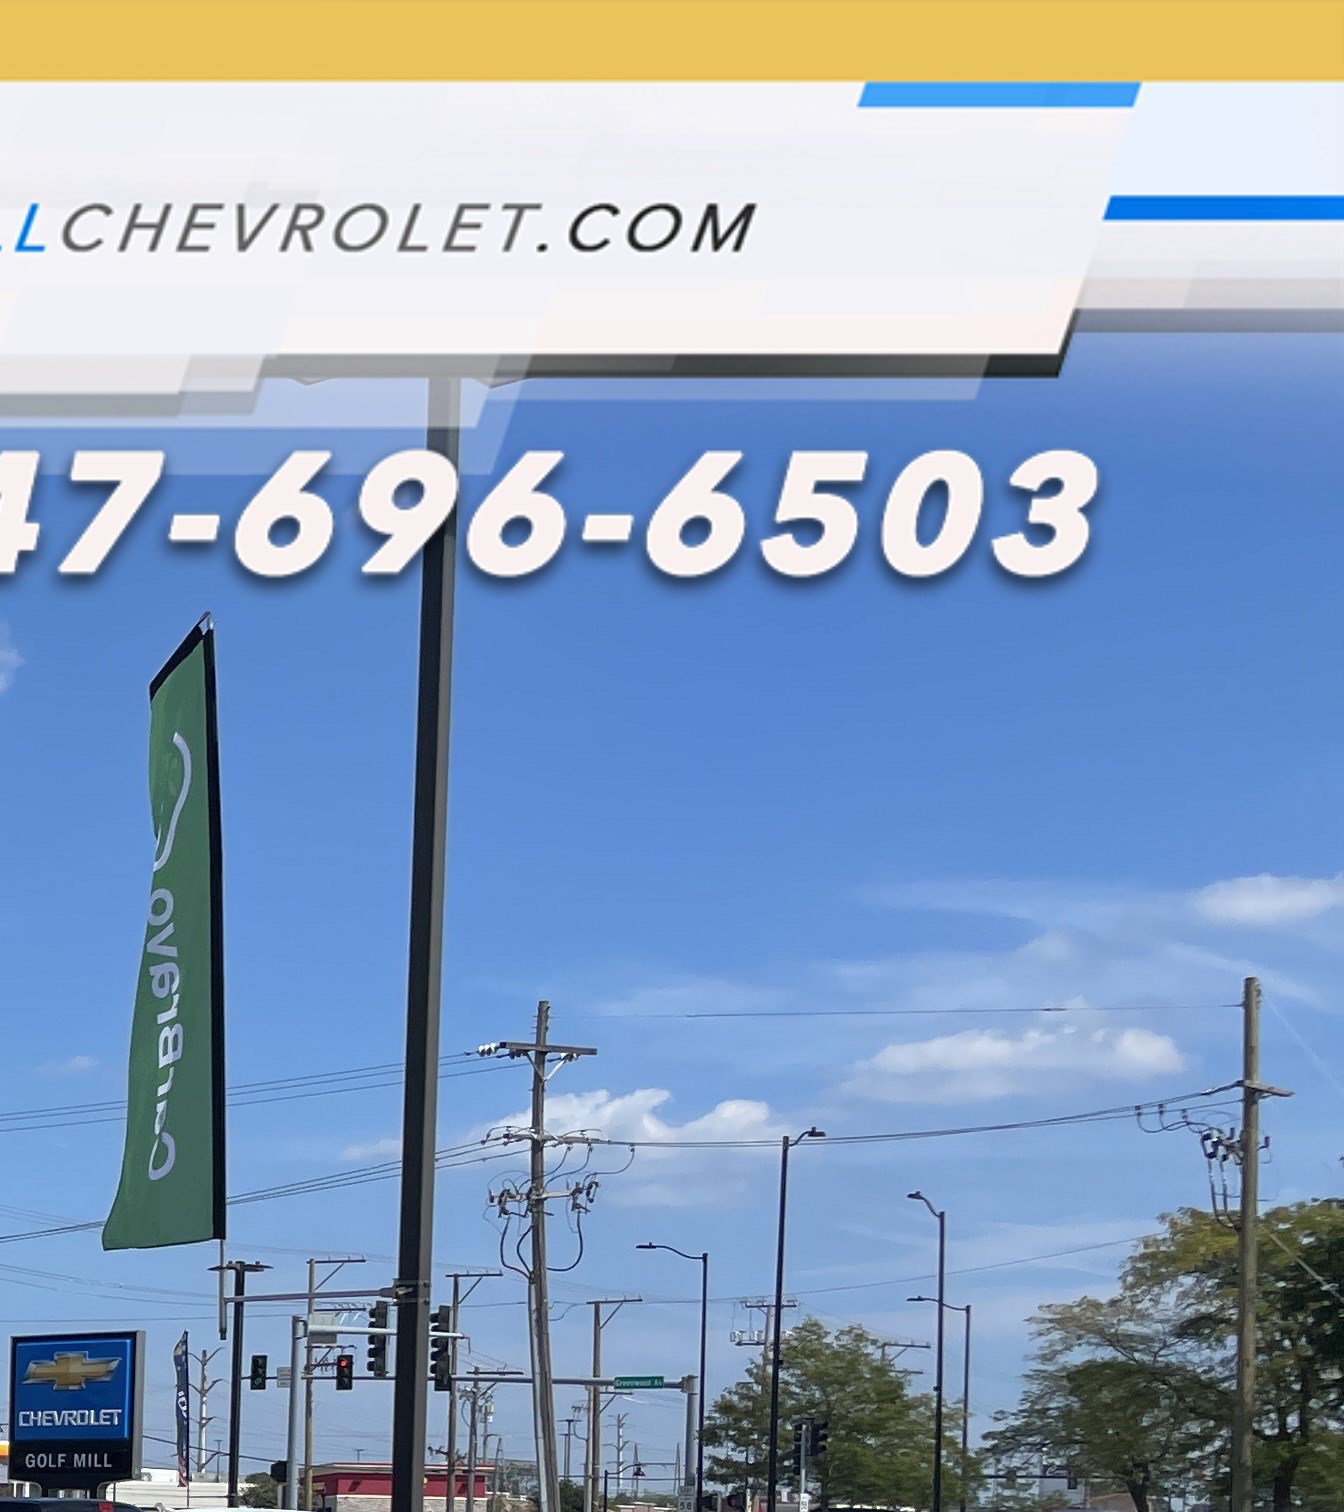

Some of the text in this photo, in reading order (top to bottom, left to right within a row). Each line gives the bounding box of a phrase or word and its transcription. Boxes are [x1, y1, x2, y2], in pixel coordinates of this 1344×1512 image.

[18, 1408, 123, 1428] CHEVROLET
[25, 1452, 112, 1469] GOLF MILL
